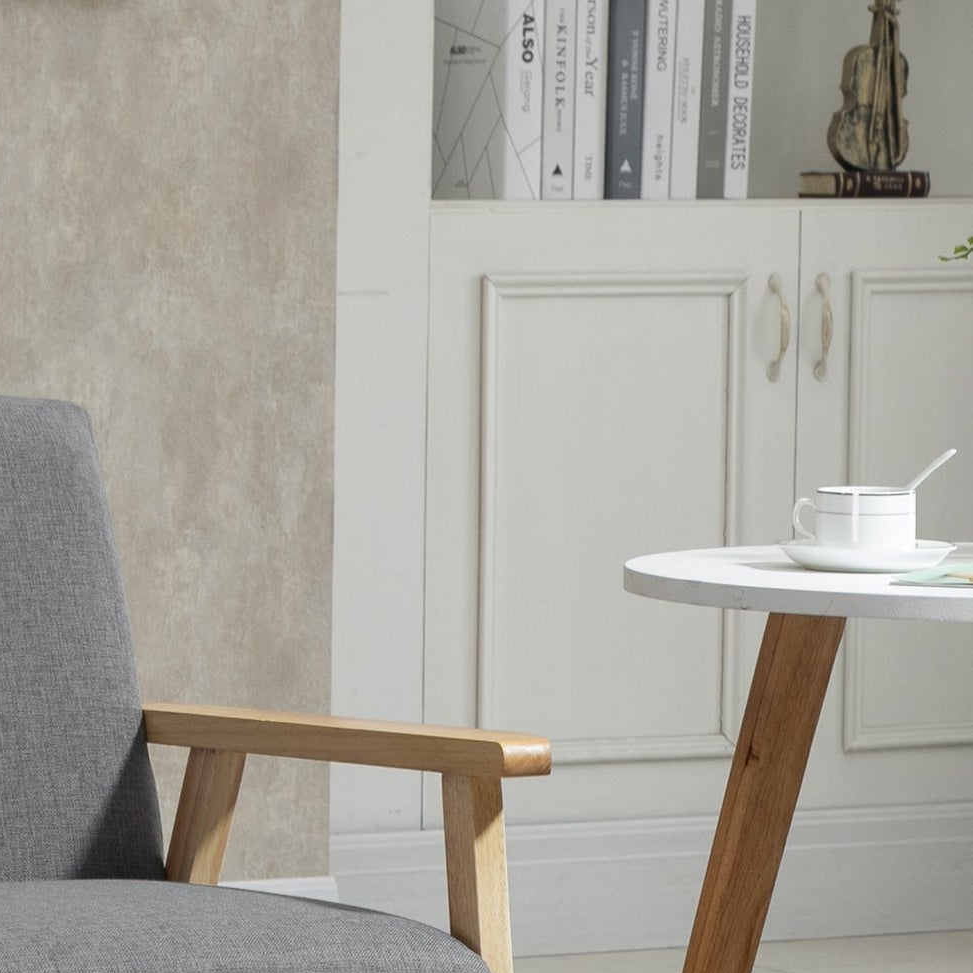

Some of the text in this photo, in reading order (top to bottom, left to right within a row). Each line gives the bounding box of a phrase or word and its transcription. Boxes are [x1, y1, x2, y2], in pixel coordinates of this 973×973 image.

[522, 13, 535, 63] ALSO
[555, 25, 568, 108] KINFOLK
[584, 58, 598, 97] Year
[731, 15, 752, 170] HOUSEHOLD DECORATES
[584, 156, 593, 182] TIME
[654, 135, 664, 181] heights
